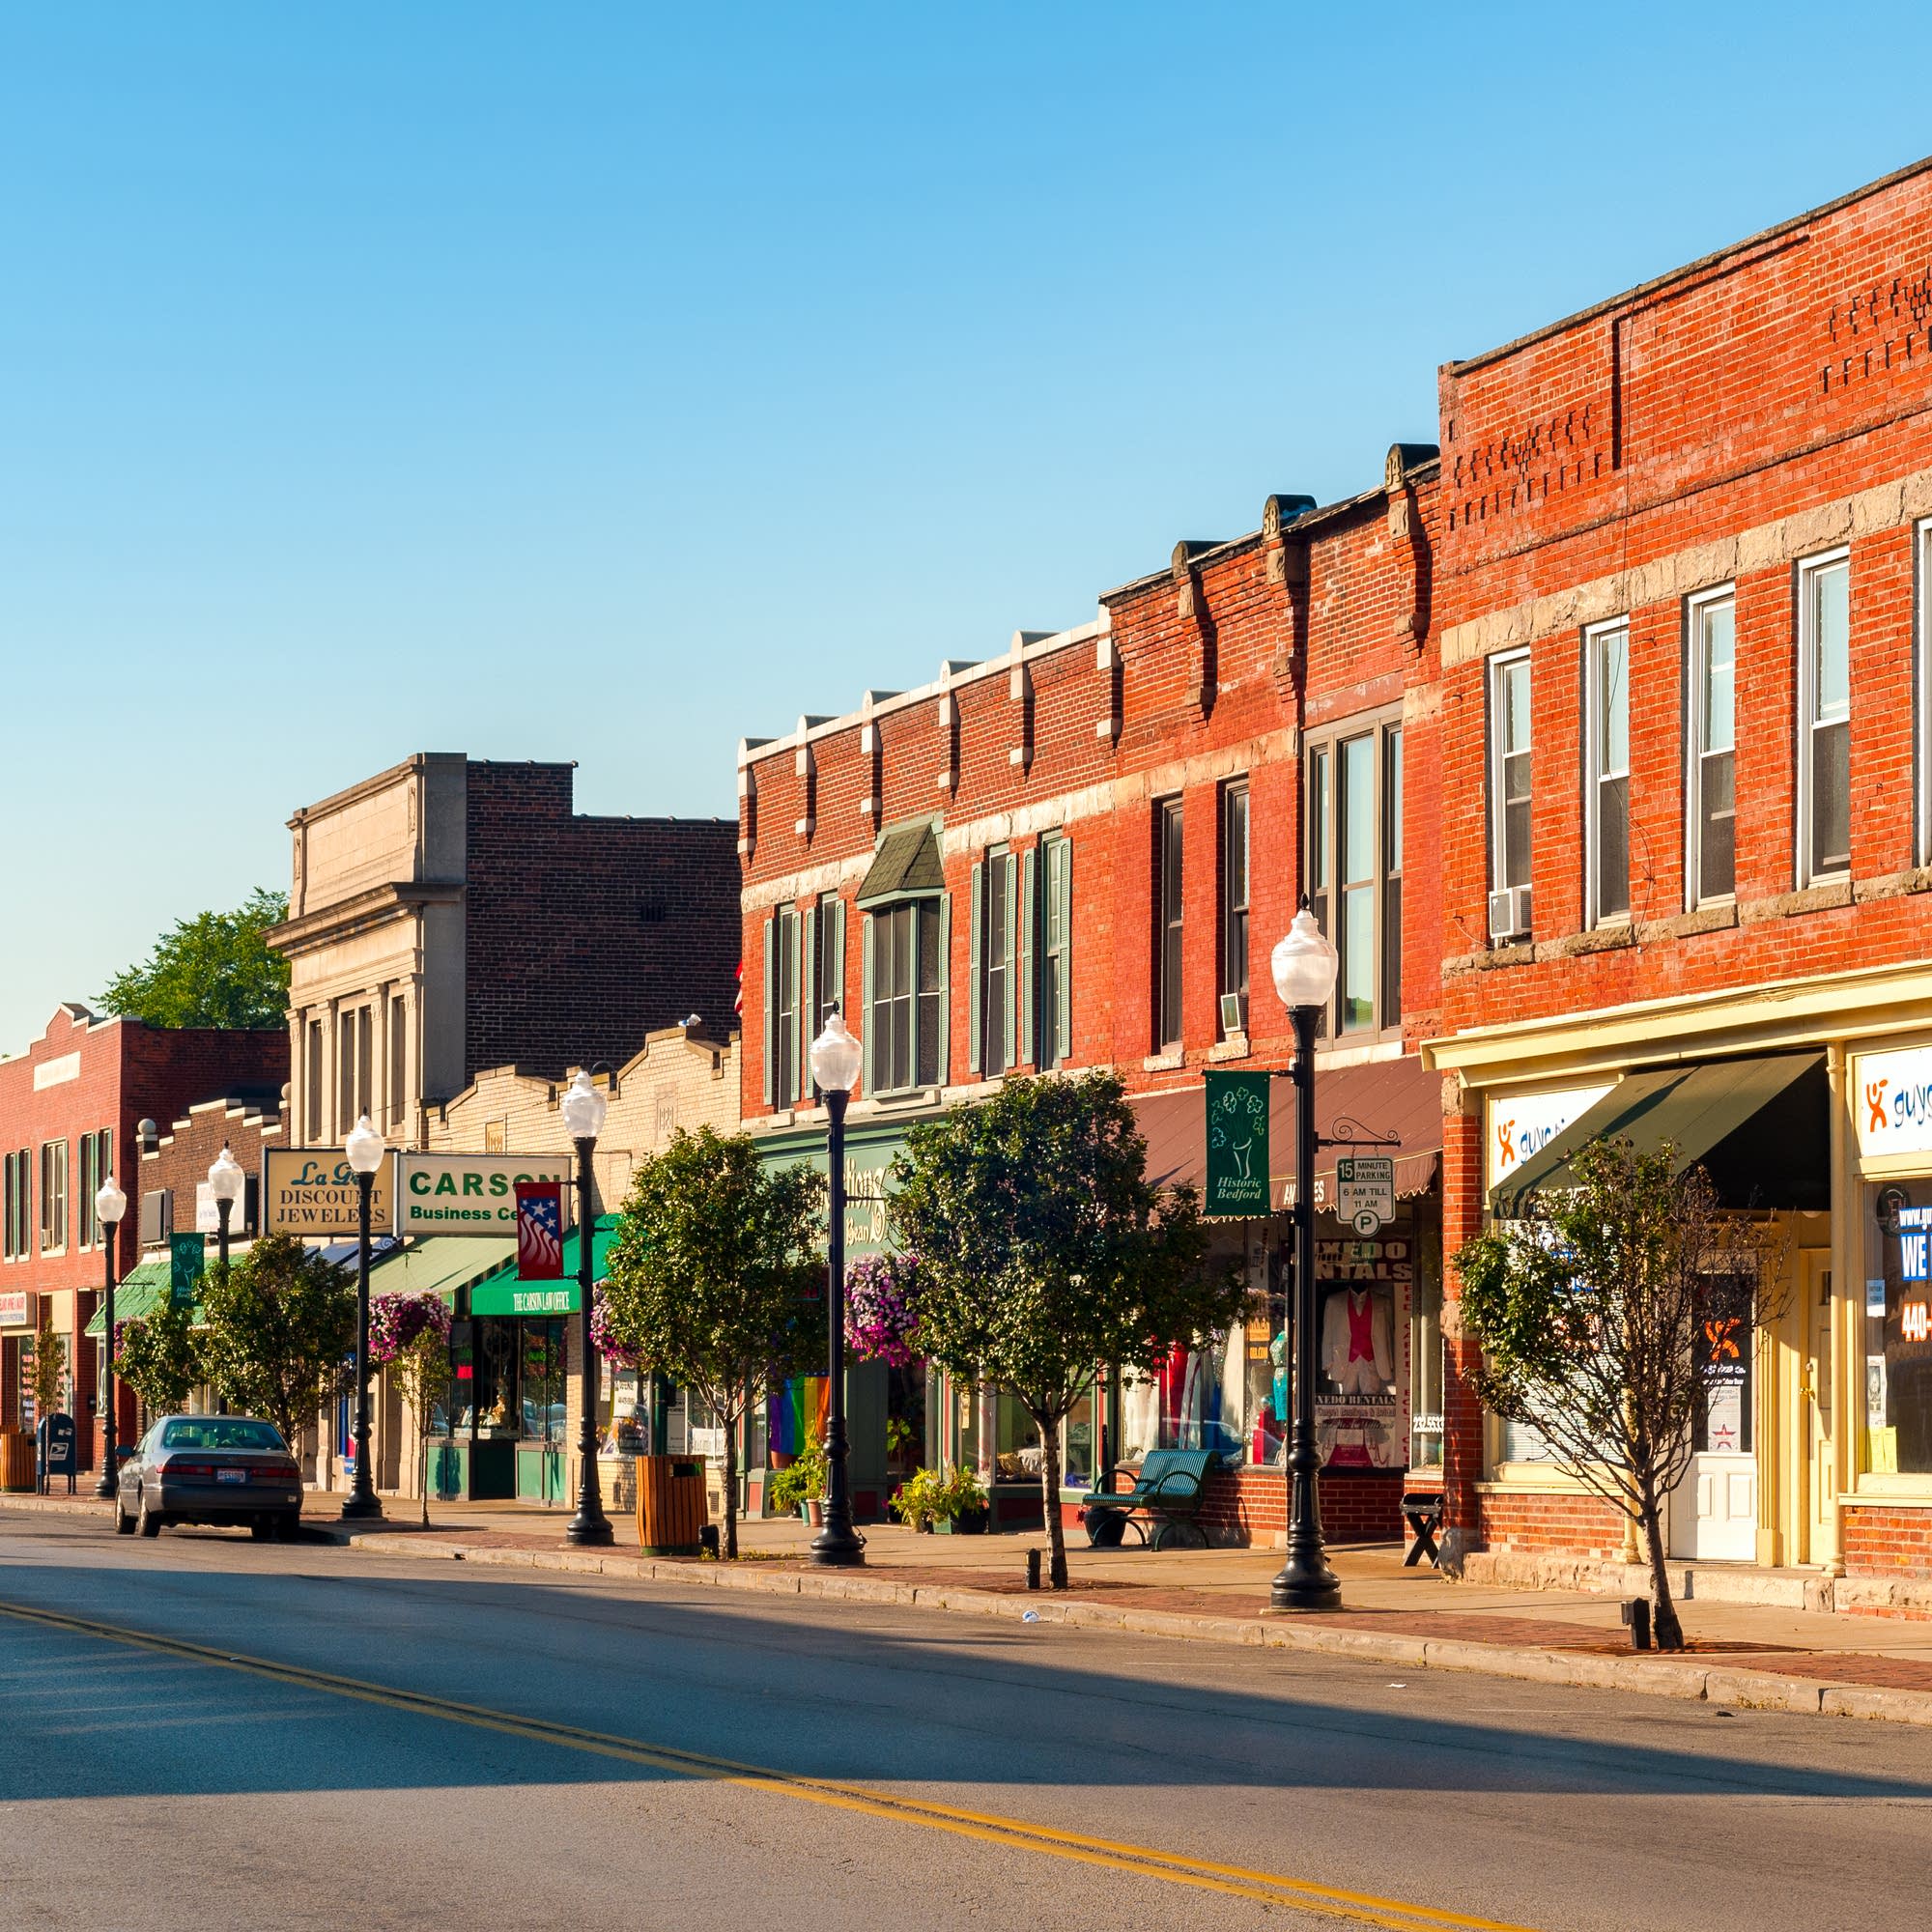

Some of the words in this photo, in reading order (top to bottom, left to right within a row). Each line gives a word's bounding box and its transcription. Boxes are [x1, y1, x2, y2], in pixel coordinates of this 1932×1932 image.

[291, 1161, 327, 1186] La
[1339, 1162, 1353, 1179] 15
[1357, 1161, 1388, 1170] MINUTE
[1217, 1177, 1262, 1188] Historic
[1355, 1171, 1391, 1179] PARKING
[1217, 1188, 1262, 1202] Bedford
[1283, 1180, 1324, 1206] ANES
[1343, 1188, 1350, 1197] 6
[1369, 1187, 1387, 1196] TILL
[276, 1208, 386, 1223] JEWELES
[410, 1206, 492, 1221] Business
[1899, 1208, 1932, 1231] www.gu
[845, 1216, 870, 1247] Bean
[1360, 1216, 1372, 1231] P
[1315, 1241, 1407, 1259] XEDO
[1901, 1235, 1927, 1278] WE
[1315, 1263, 1412, 1280] NTALS
[1901, 1303, 1932, 1342] 440-
[1316, 1394, 1347, 1406] XEDO
[1349, 1394, 1396, 1406] RENTALS
